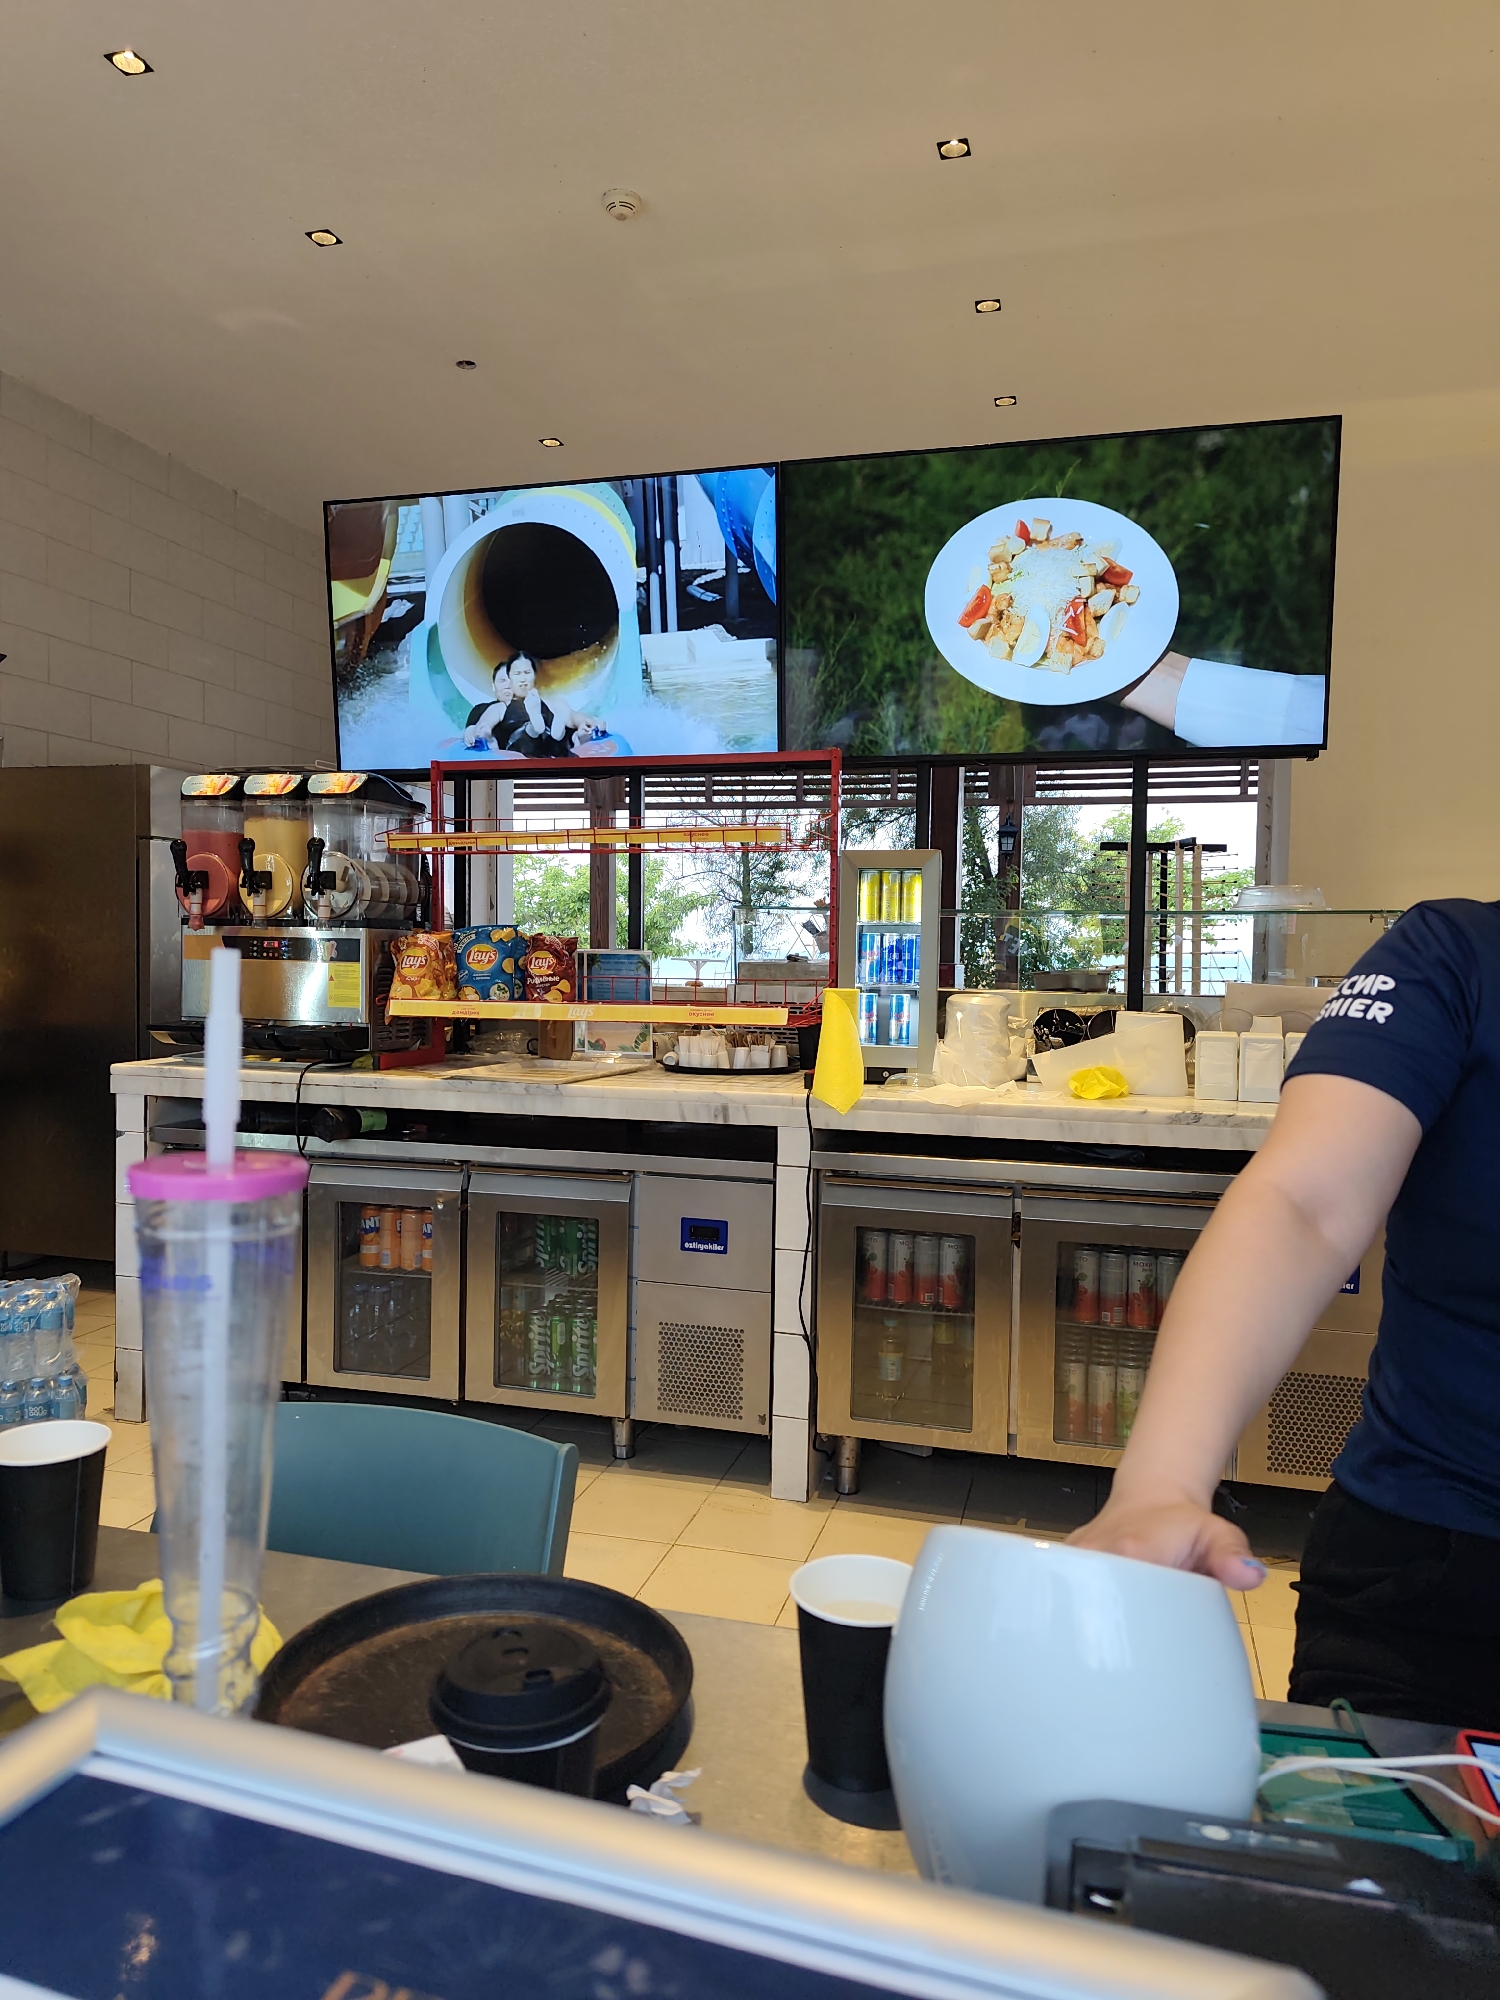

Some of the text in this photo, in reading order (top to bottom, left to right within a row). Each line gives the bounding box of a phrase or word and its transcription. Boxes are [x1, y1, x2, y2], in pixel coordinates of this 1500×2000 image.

[402, 955, 427, 969] Lay's
[468, 949, 497, 965] Lay's
[531, 957, 554, 970] Lay's
[567, 1004, 595, 1020] Lay's
[528, 1314, 554, 1375] Sprite
[573, 1318, 590, 1376] Sprite
